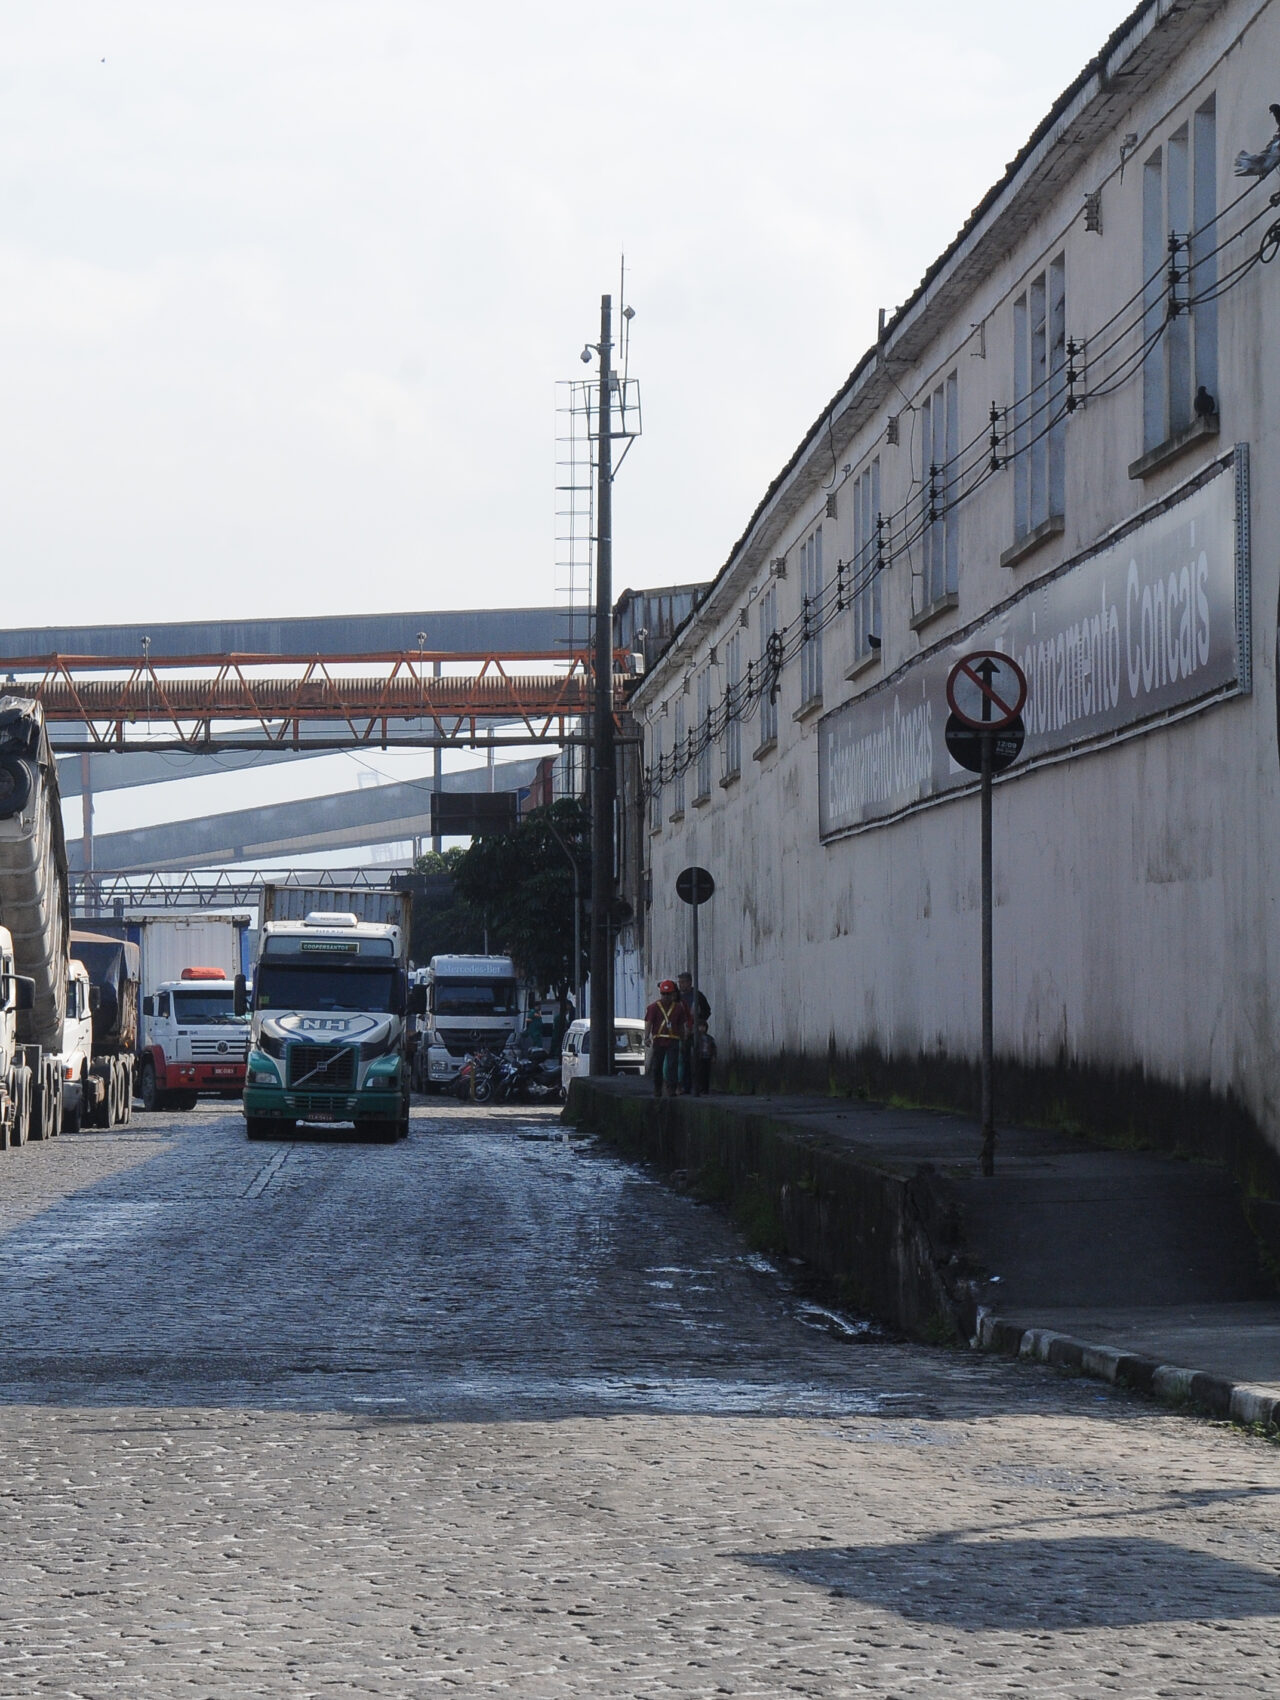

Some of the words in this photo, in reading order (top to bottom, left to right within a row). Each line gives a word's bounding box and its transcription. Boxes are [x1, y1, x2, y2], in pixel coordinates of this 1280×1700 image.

[1126, 519, 1211, 698] Concais
[894, 678, 933, 794] Concais
[303, 1019, 345, 1030] NH
